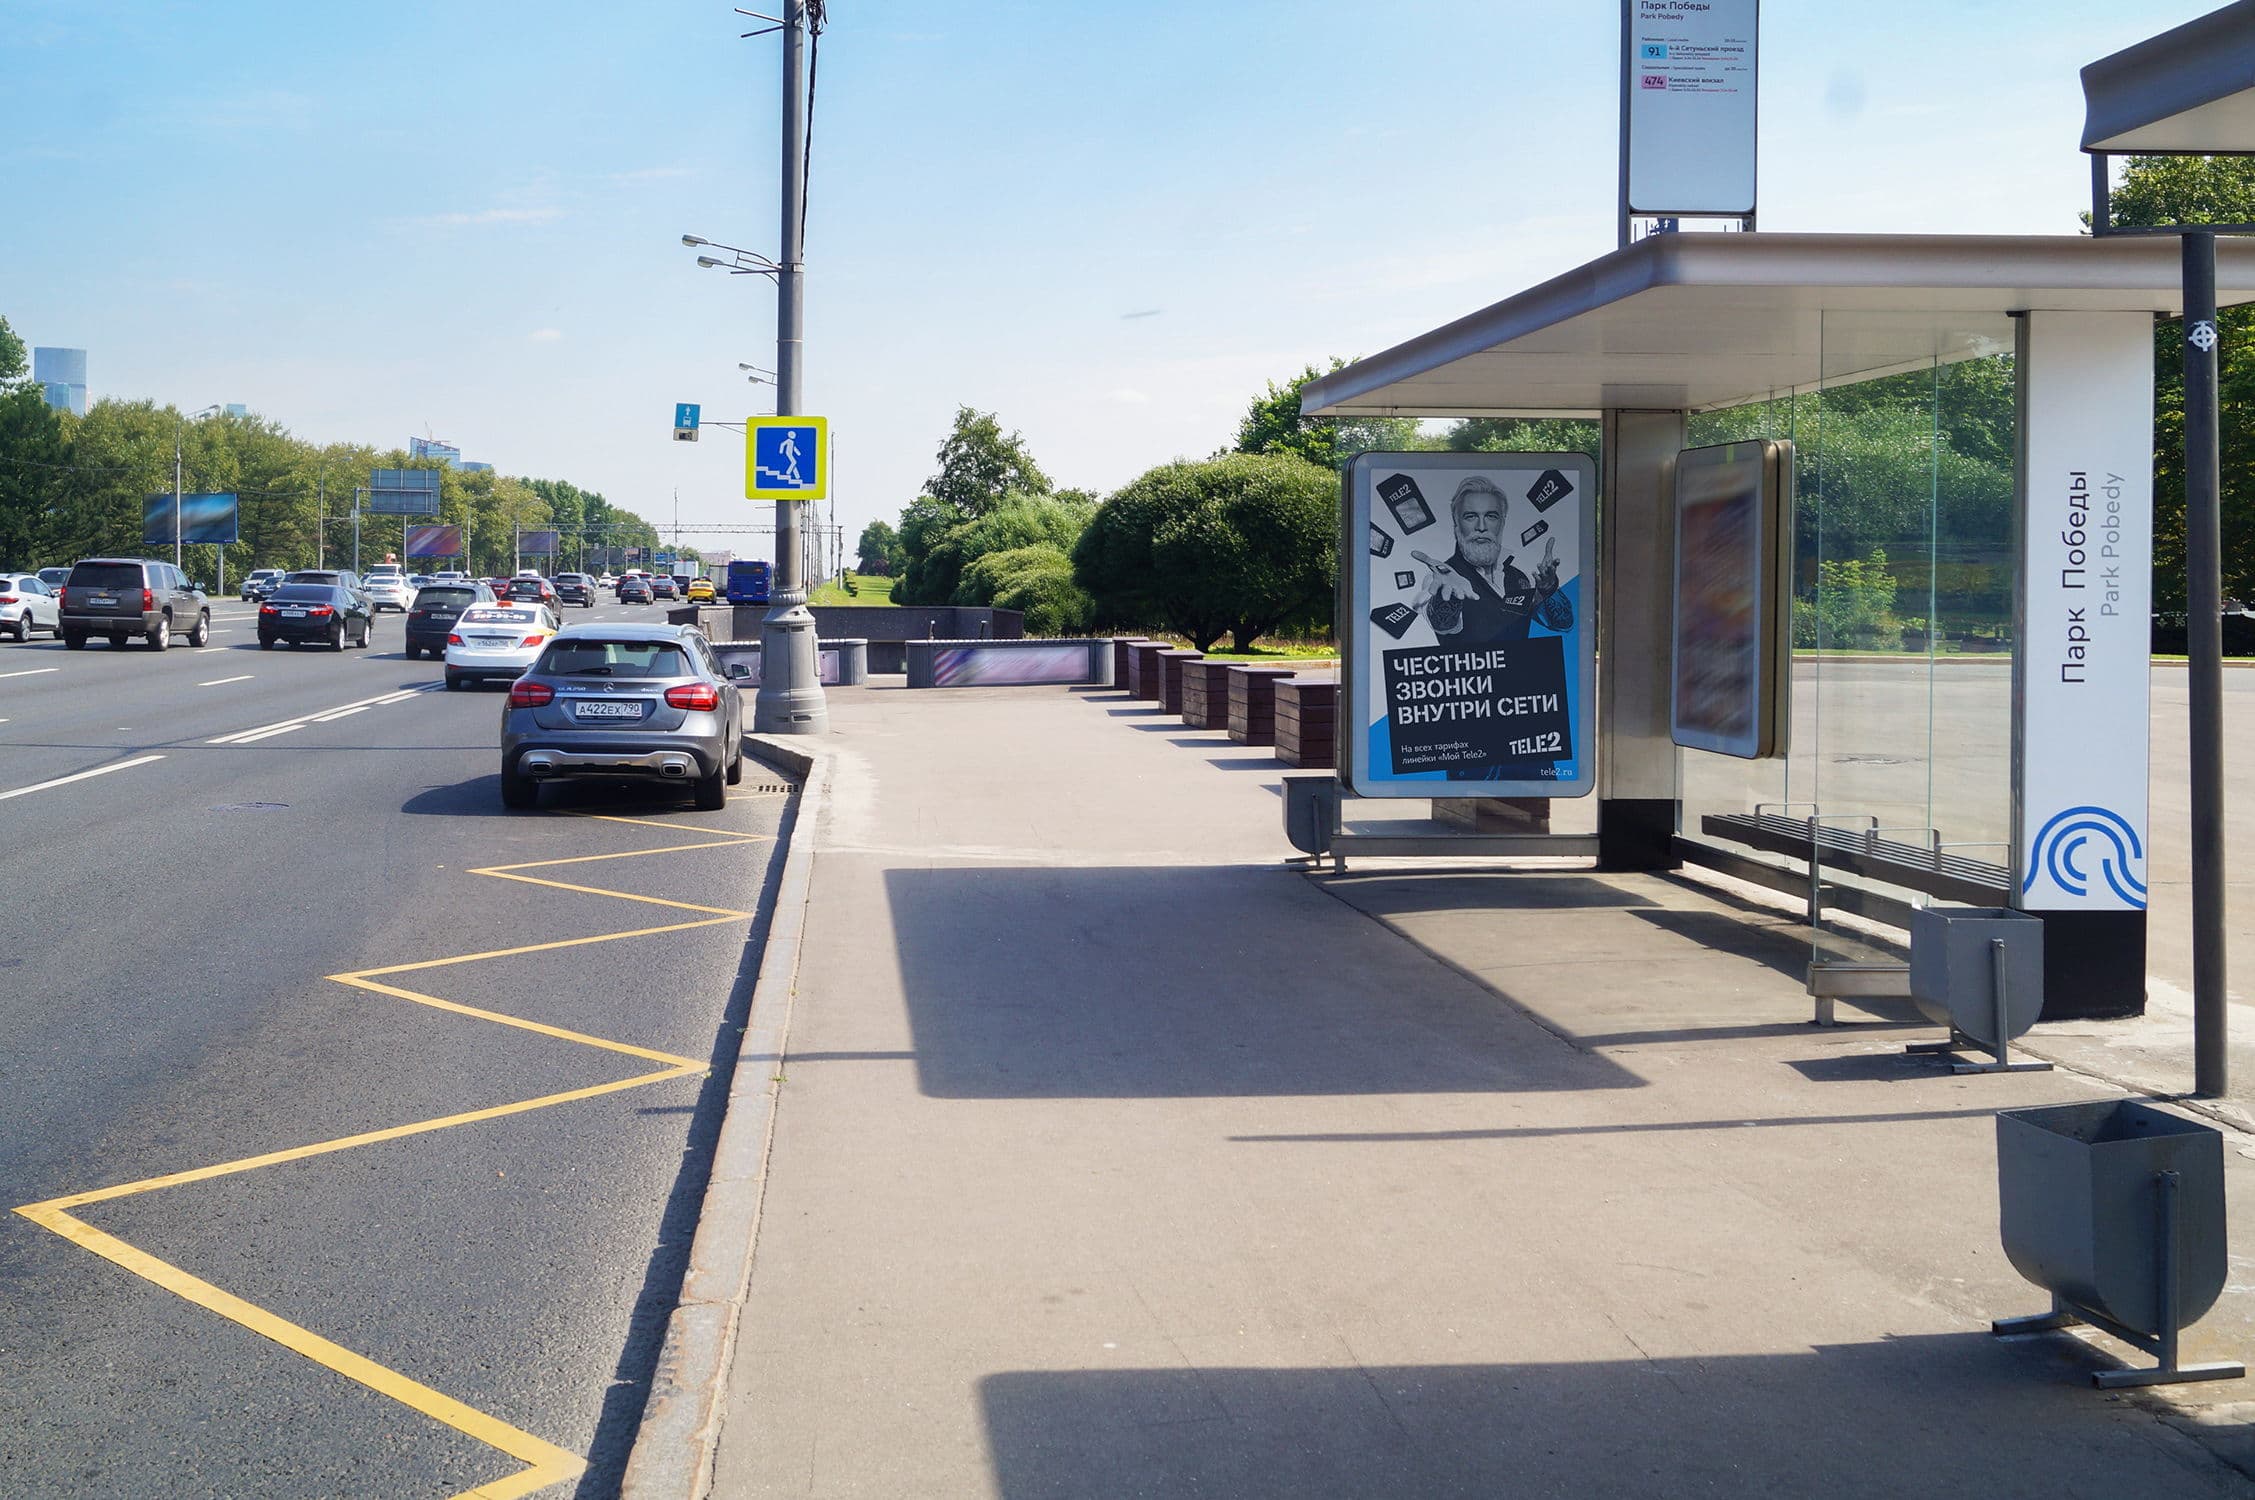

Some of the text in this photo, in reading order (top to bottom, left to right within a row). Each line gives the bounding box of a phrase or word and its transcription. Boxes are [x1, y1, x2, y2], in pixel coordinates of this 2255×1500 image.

[1641, 1, 1710, 11] Парк Победы
[1658, 13, 1684, 21] Pobedy
[1648, 47, 1660, 56] 91
[1645, 76, 1663, 85] 474
[1389, 483, 1412, 503] TELE2
[1536, 480, 1560, 504] TELE2
[2100, 472, 2125, 616] Park Pobedy
[2061, 471, 2091, 683] Парк Победы
[1385, 606, 1410, 624] TELE2
[1393, 650, 1506, 677] ЧЕСТНЫЕ
[1396, 675, 1493, 701] ЗВОНКИ
[1398, 693, 1559, 725] ВНУТРИ СЕТИ
[1401, 741, 1469, 753] На всех тарифах
[1509, 731, 1562, 755] TELE2
[1402, 749, 1487, 765] линейки «Мой Tele2»
[1540, 767, 1573, 777] tele2.ru
